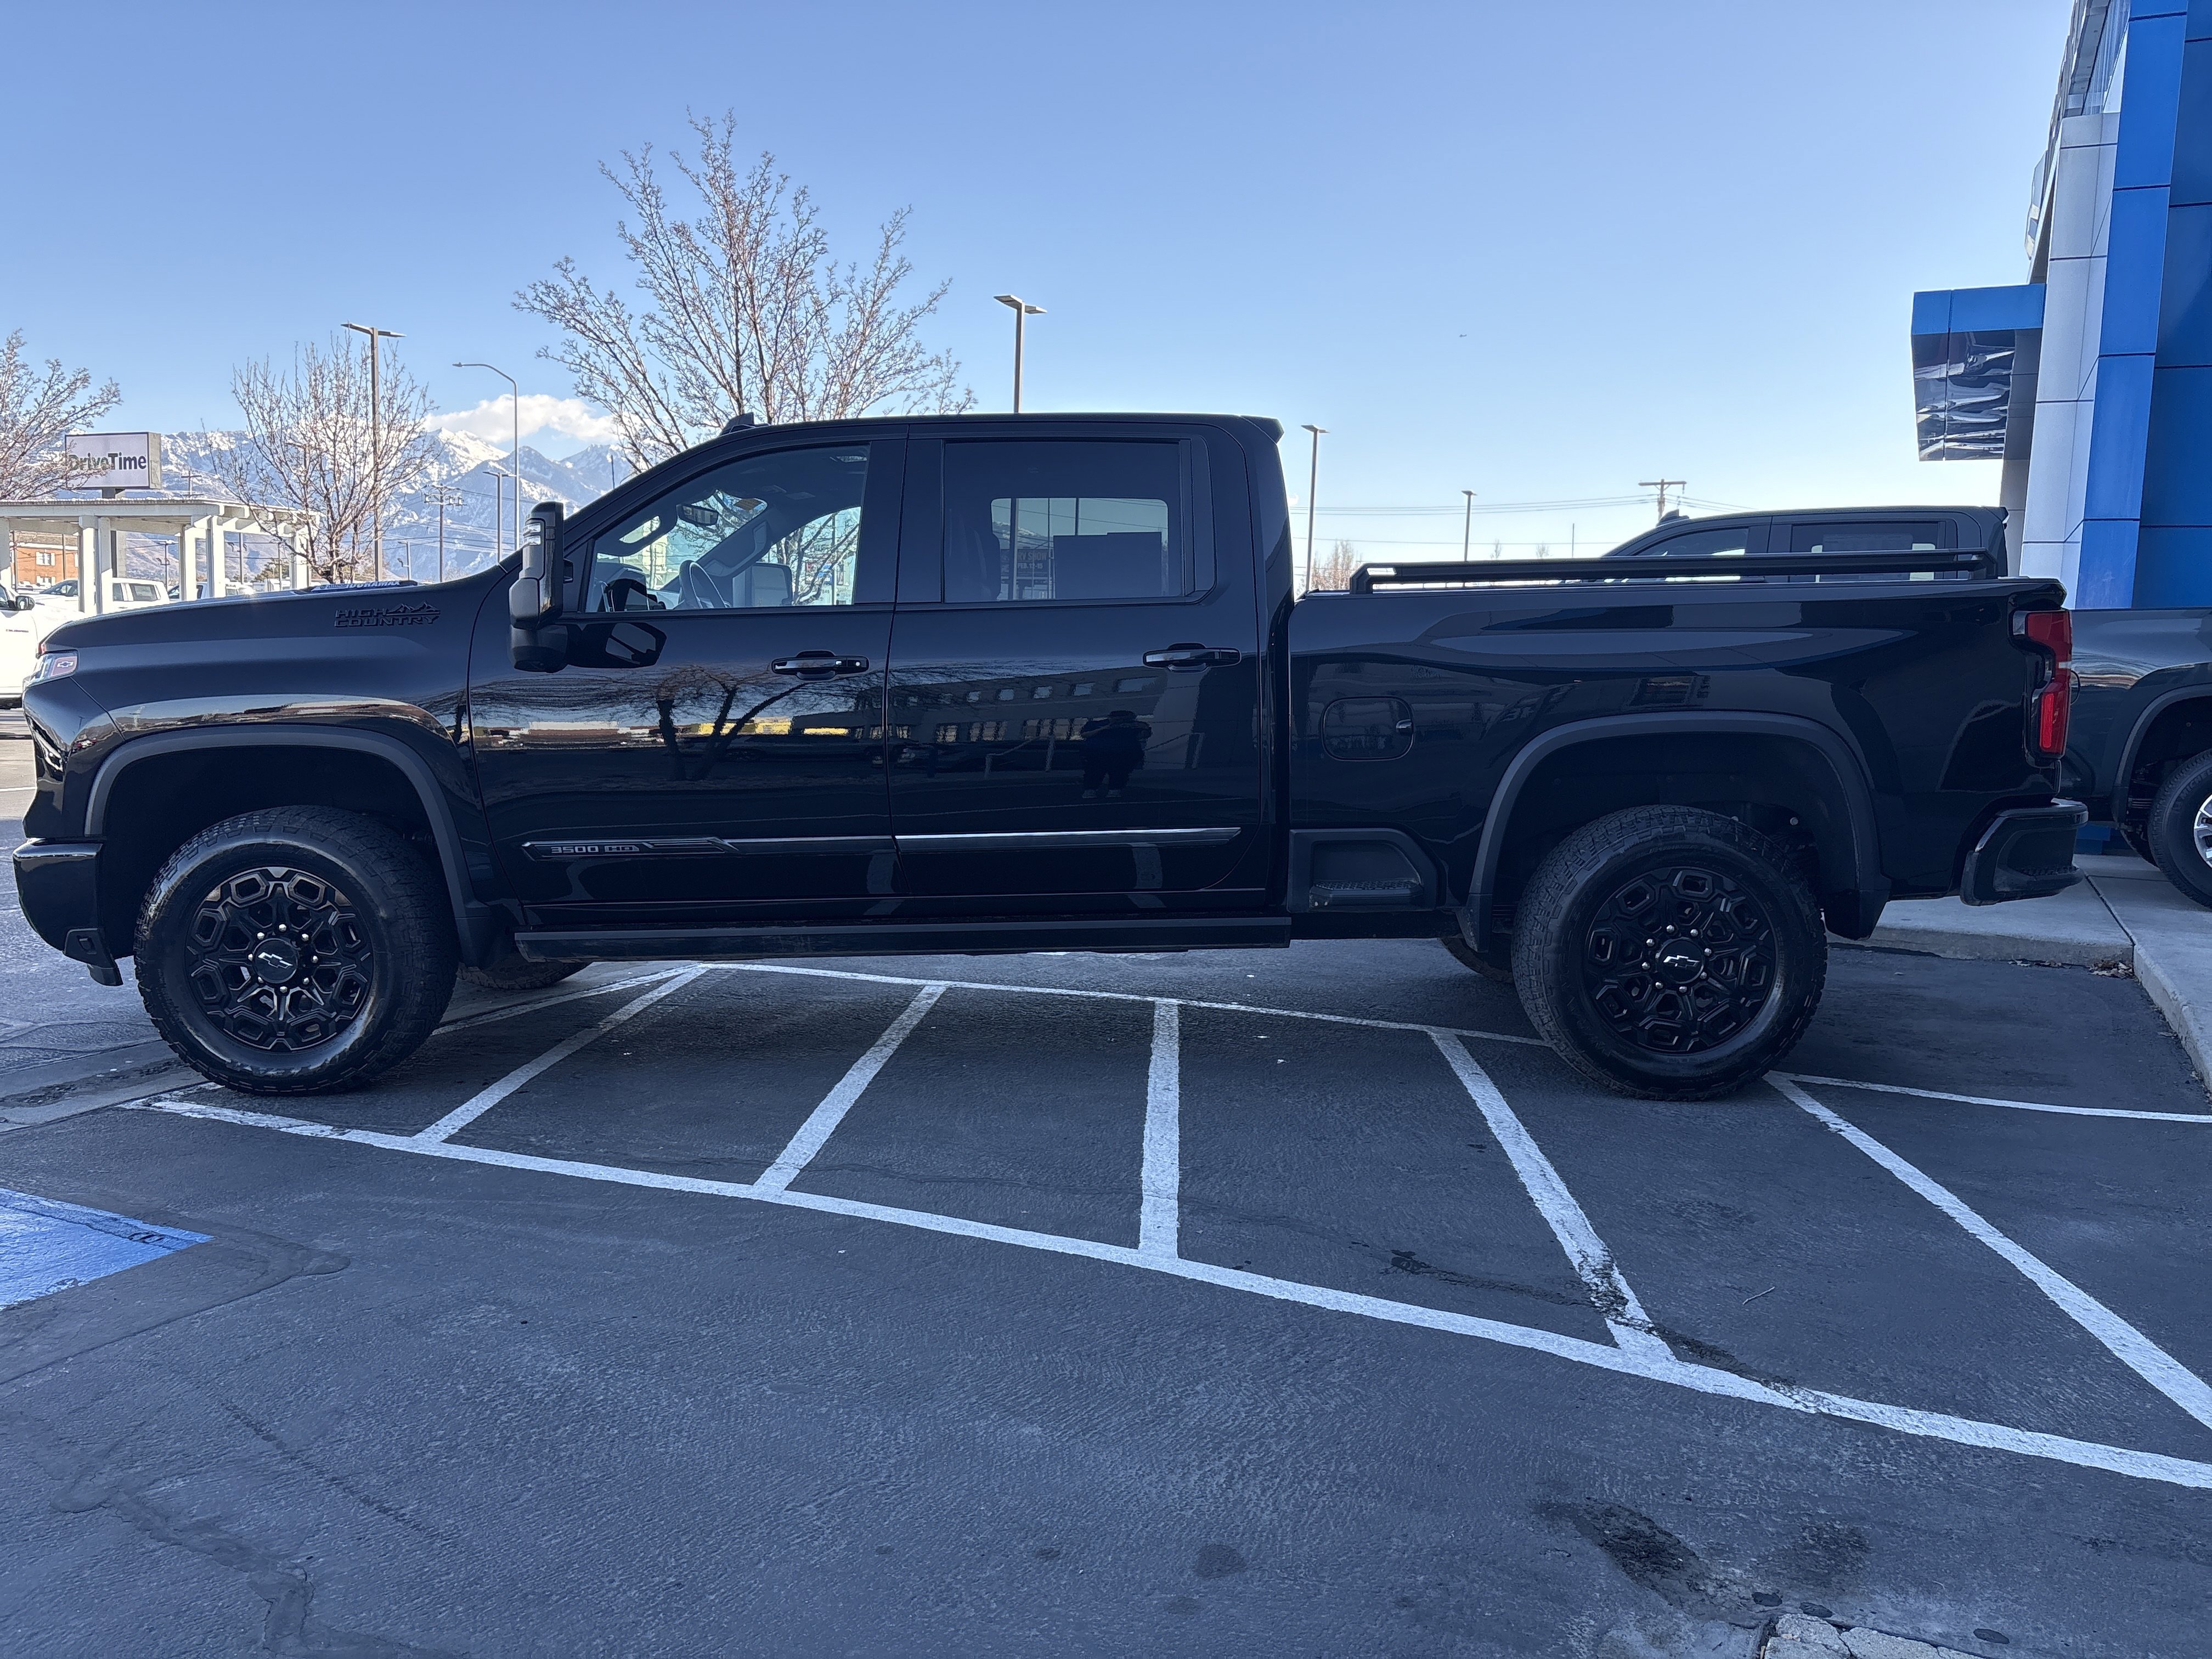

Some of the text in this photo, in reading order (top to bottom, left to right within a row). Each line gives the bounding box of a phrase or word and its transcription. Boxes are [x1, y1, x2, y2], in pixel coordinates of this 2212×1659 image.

[69, 452, 146, 470] DriveTime
[335, 608, 387, 617] HIGH
[334, 616, 439, 627] COUNTRY
[550, 844, 640, 854] 3500 HD
